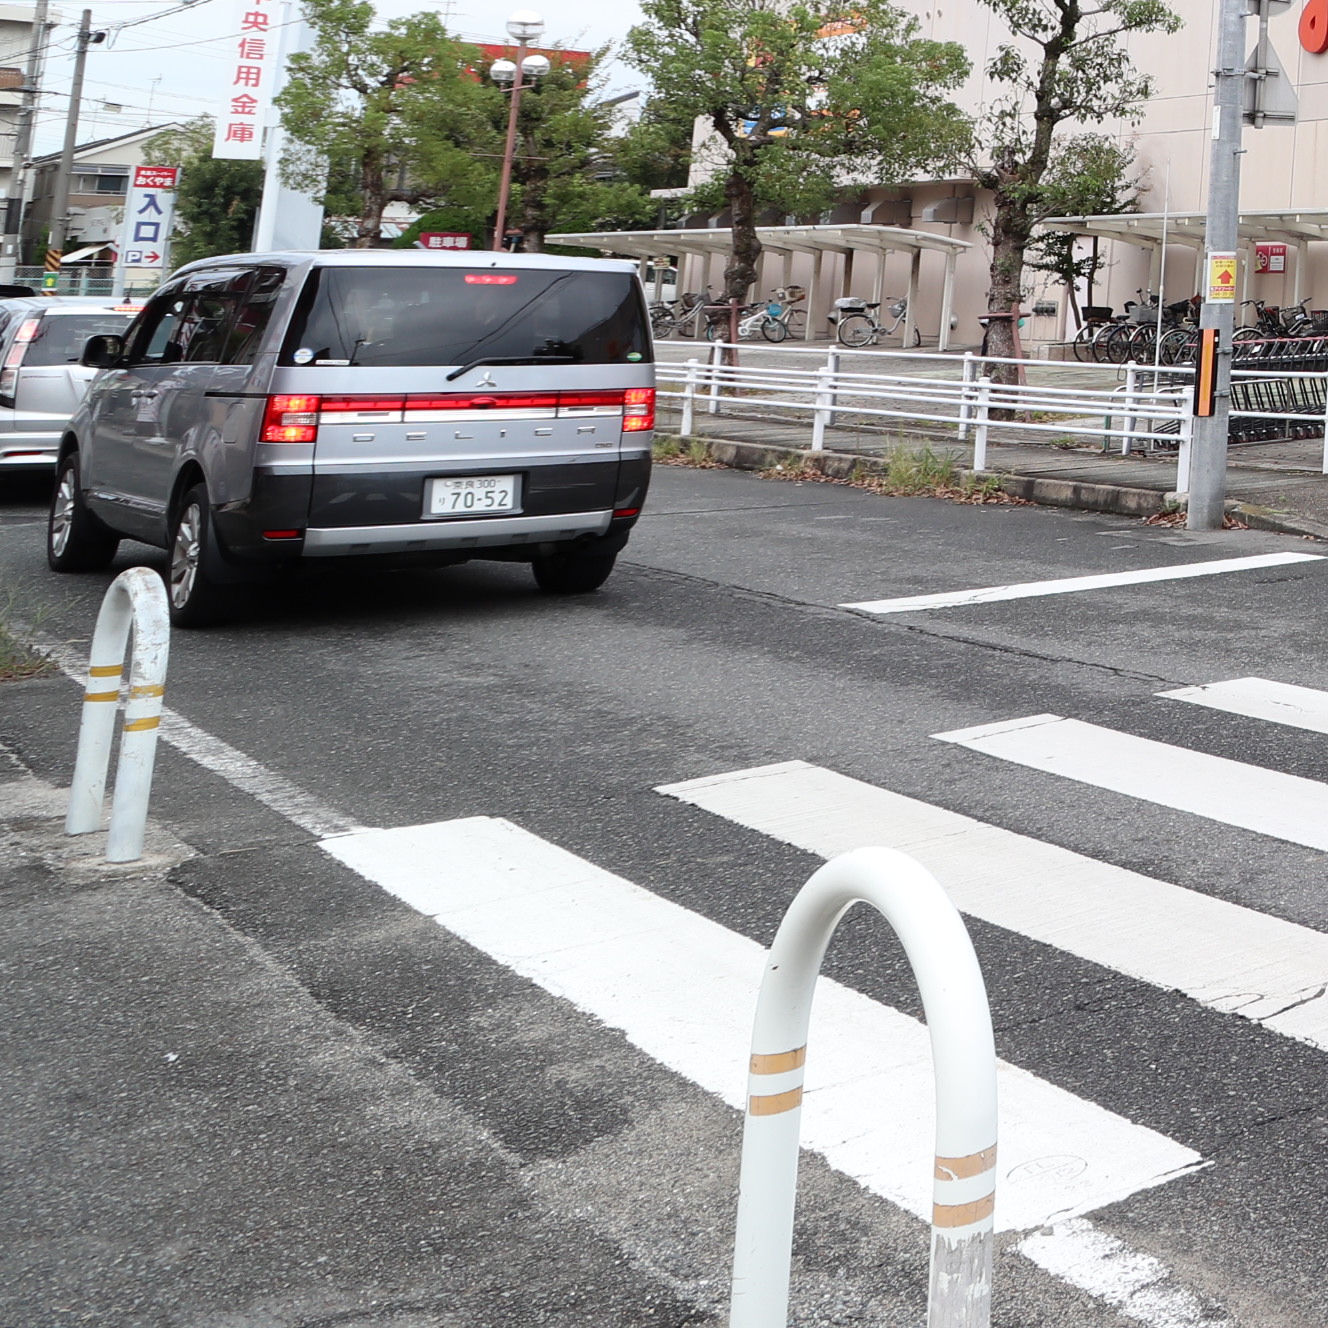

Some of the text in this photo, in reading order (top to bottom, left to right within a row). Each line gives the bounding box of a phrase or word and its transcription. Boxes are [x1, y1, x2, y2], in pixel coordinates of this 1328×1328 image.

[136, 176, 174, 186] おくやま
[133, 193, 164, 243] 入口
[127, 252, 141, 263] P
[476, 479, 496, 489] 300
[451, 490, 509, 510] 70-52
